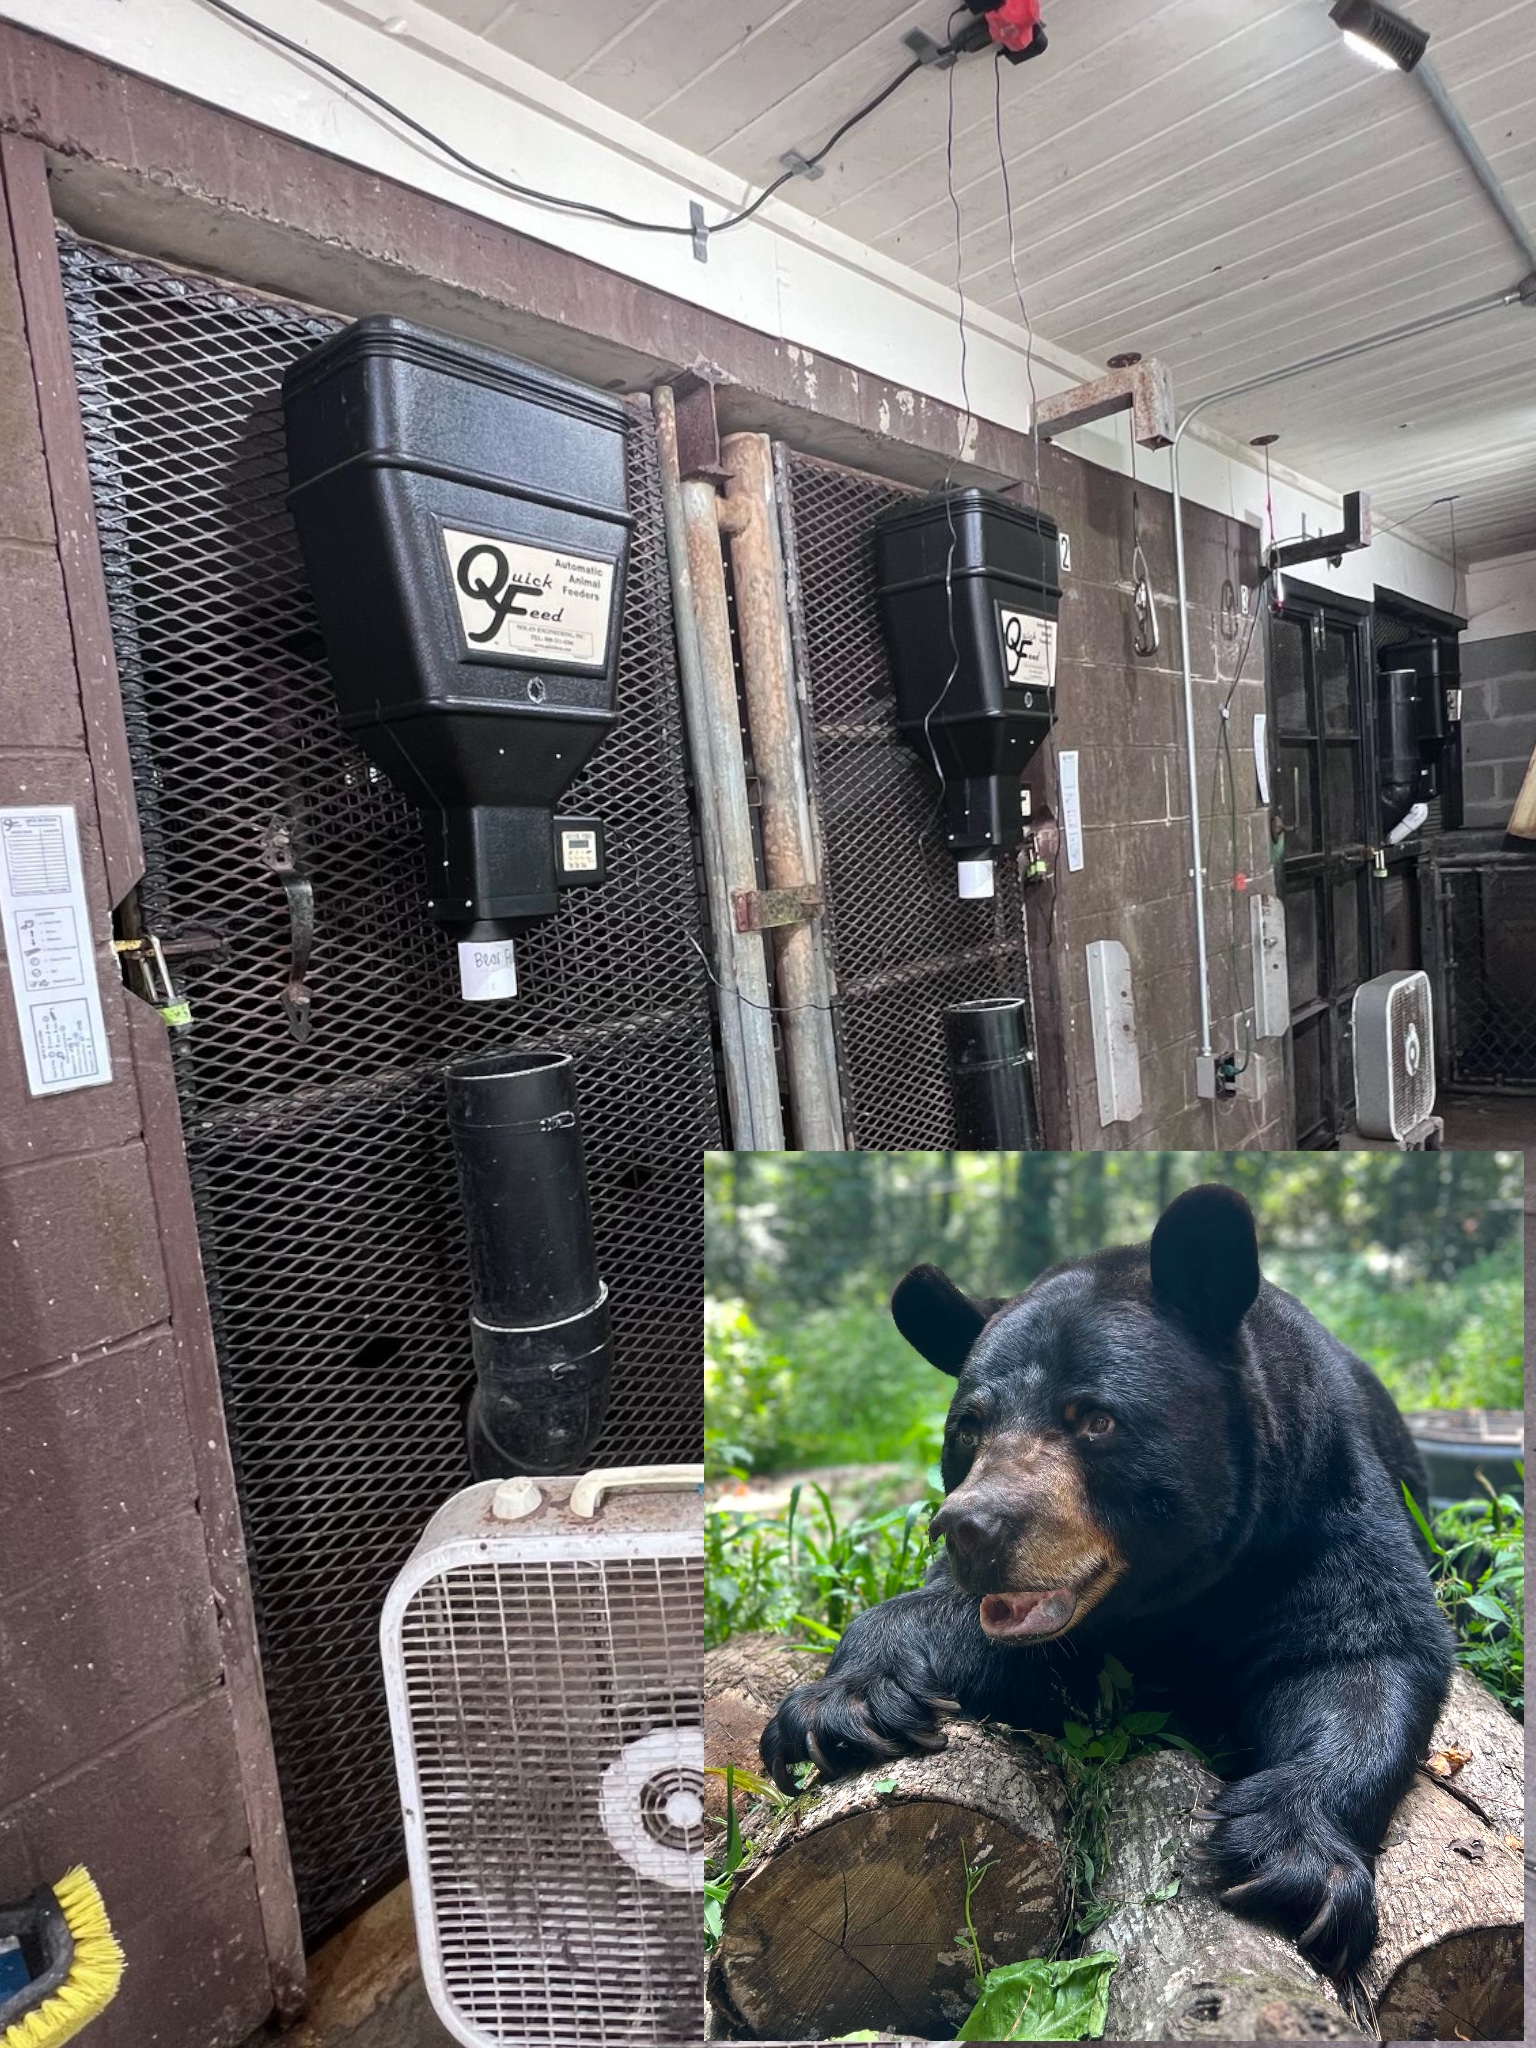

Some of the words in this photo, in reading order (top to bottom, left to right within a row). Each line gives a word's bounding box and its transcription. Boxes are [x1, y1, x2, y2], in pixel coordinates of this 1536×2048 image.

[1061, 536, 1069, 569] 2
[555, 558, 603, 577] Automatic
[457, 544, 553, 612] Quick
[569, 574, 601, 589] Animal
[562, 585, 600, 601] Feeders
[468, 584, 564, 643] Feed
[474, 952, 500, 968] Bear
